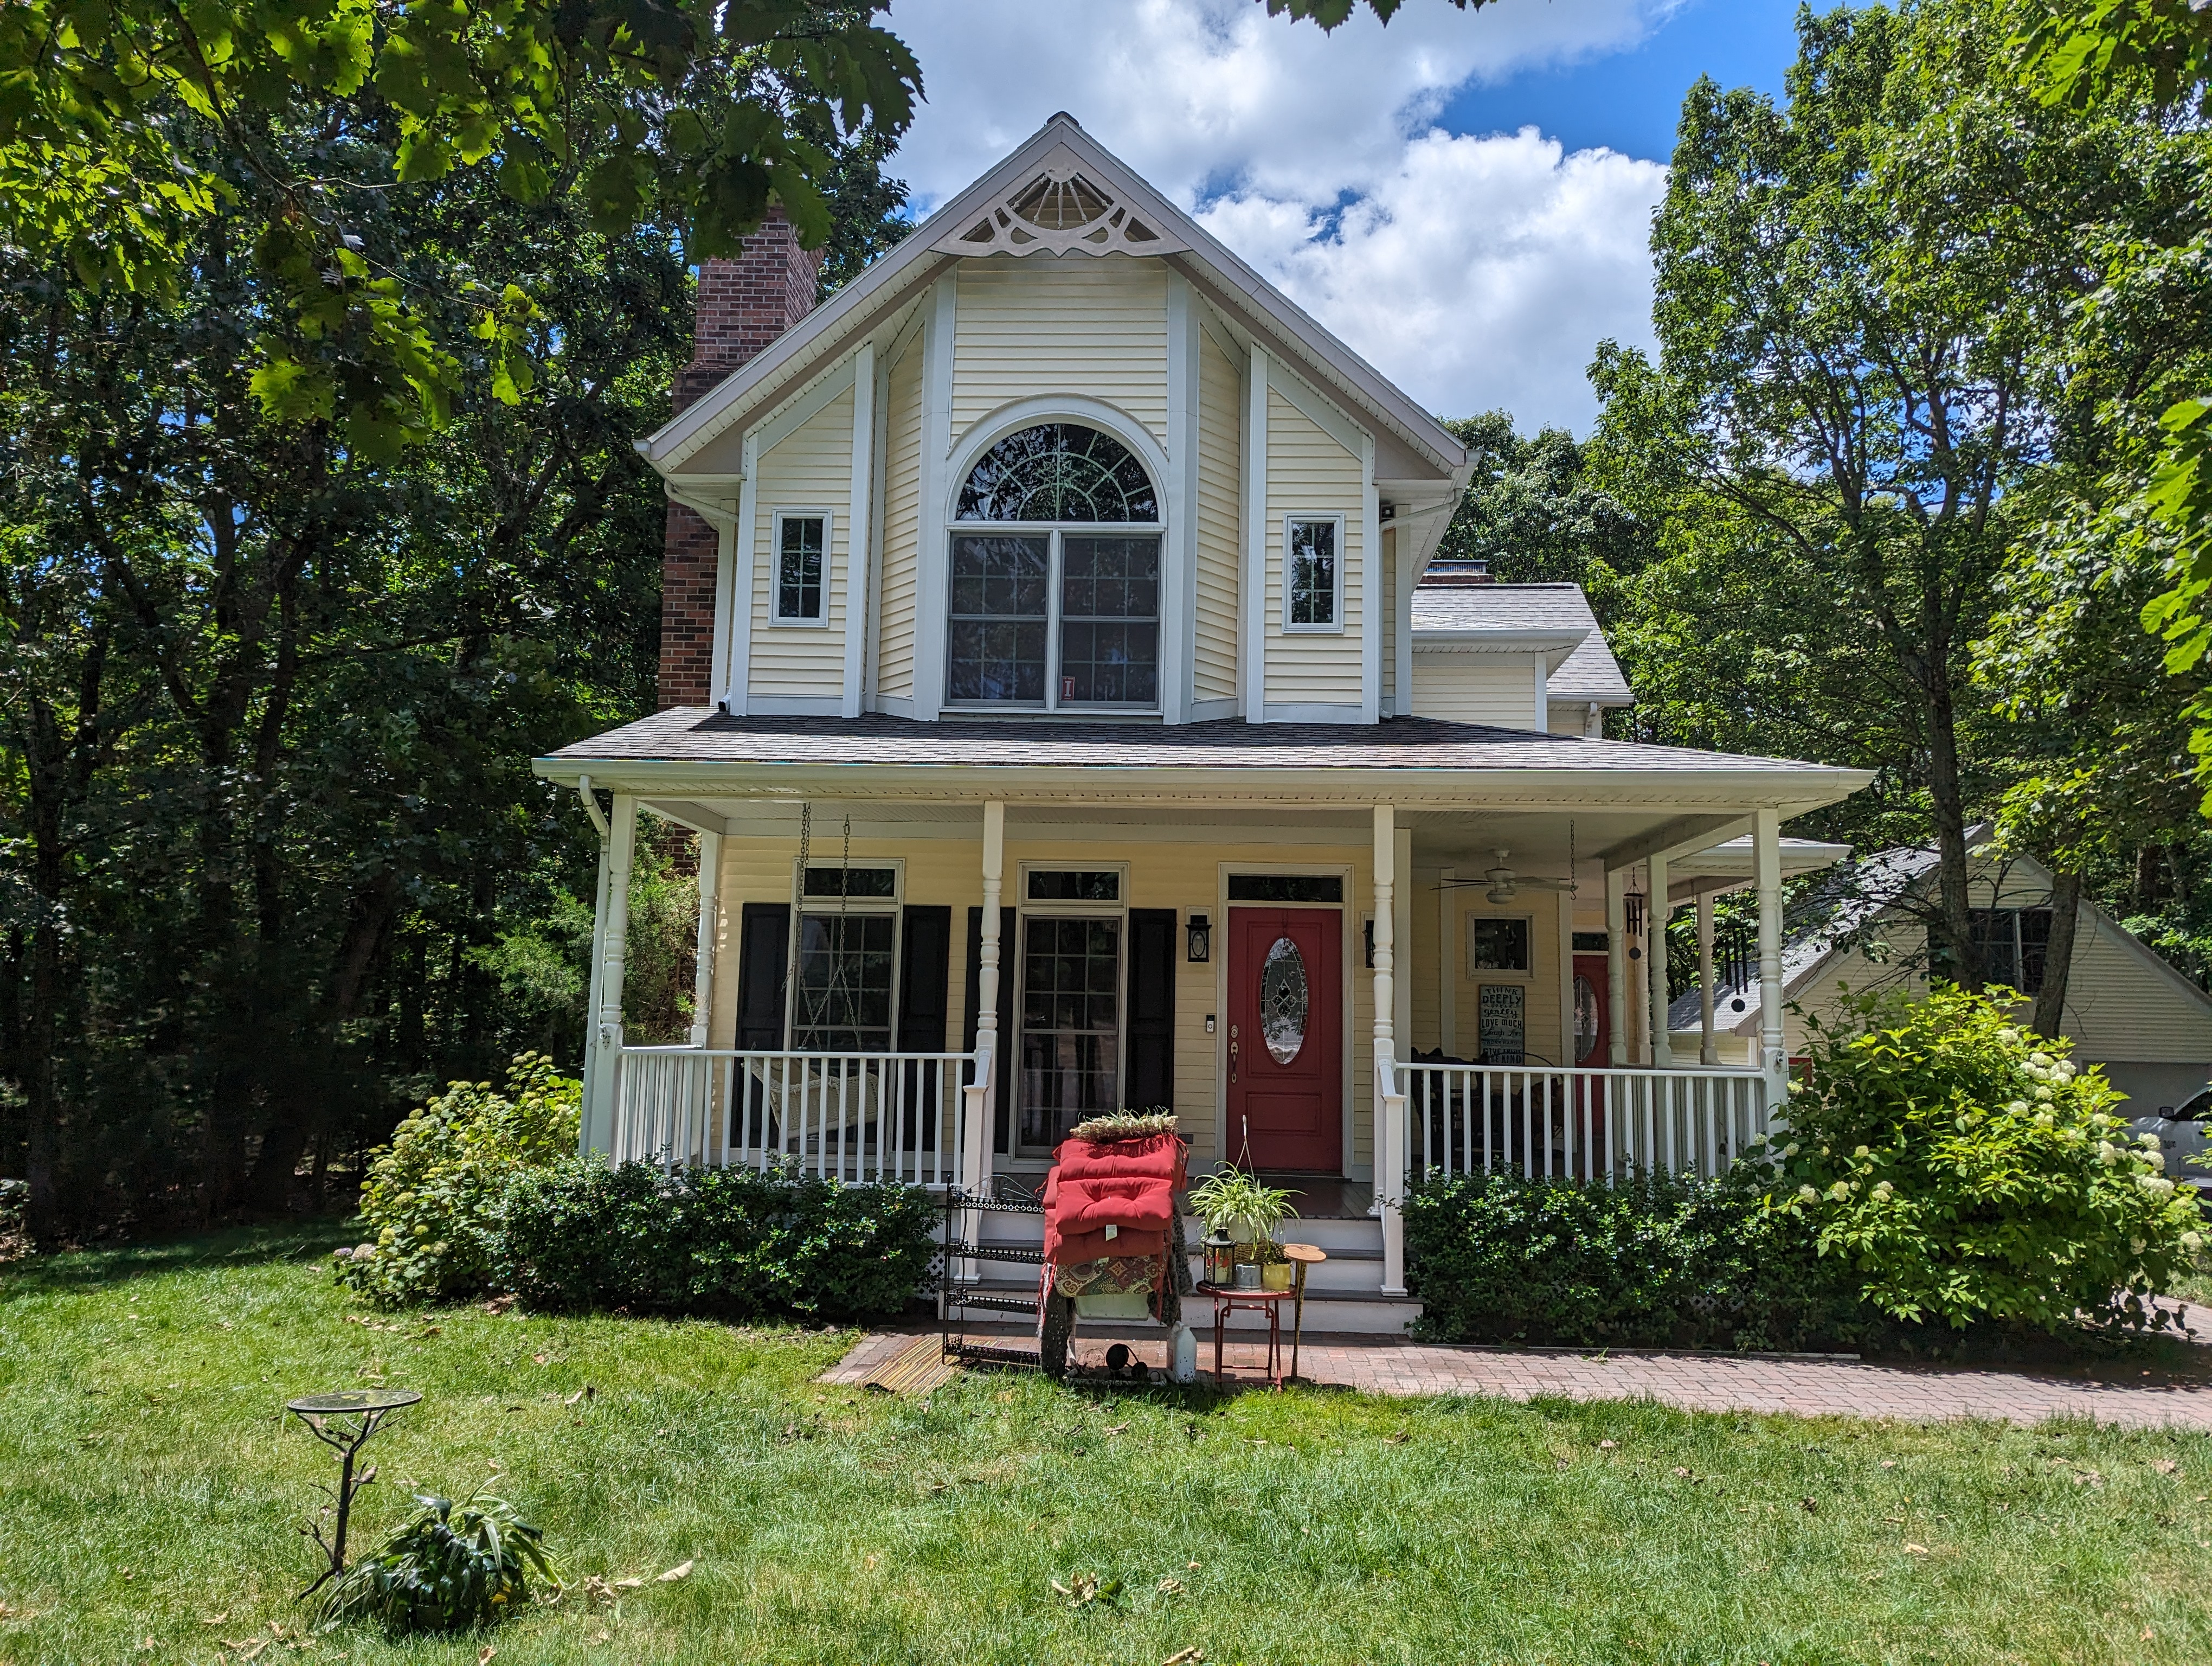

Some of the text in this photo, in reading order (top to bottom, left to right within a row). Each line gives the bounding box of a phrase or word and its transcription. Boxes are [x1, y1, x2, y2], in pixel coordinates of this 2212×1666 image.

[1485, 987, 1518, 995] THINK
[1482, 994, 1521, 1004] DEEPLY
[1483, 1008, 1519, 1019] gently
[1482, 1018, 1522, 1029] LOVE MUCH
[1501, 1055, 1521, 1063] KIND
